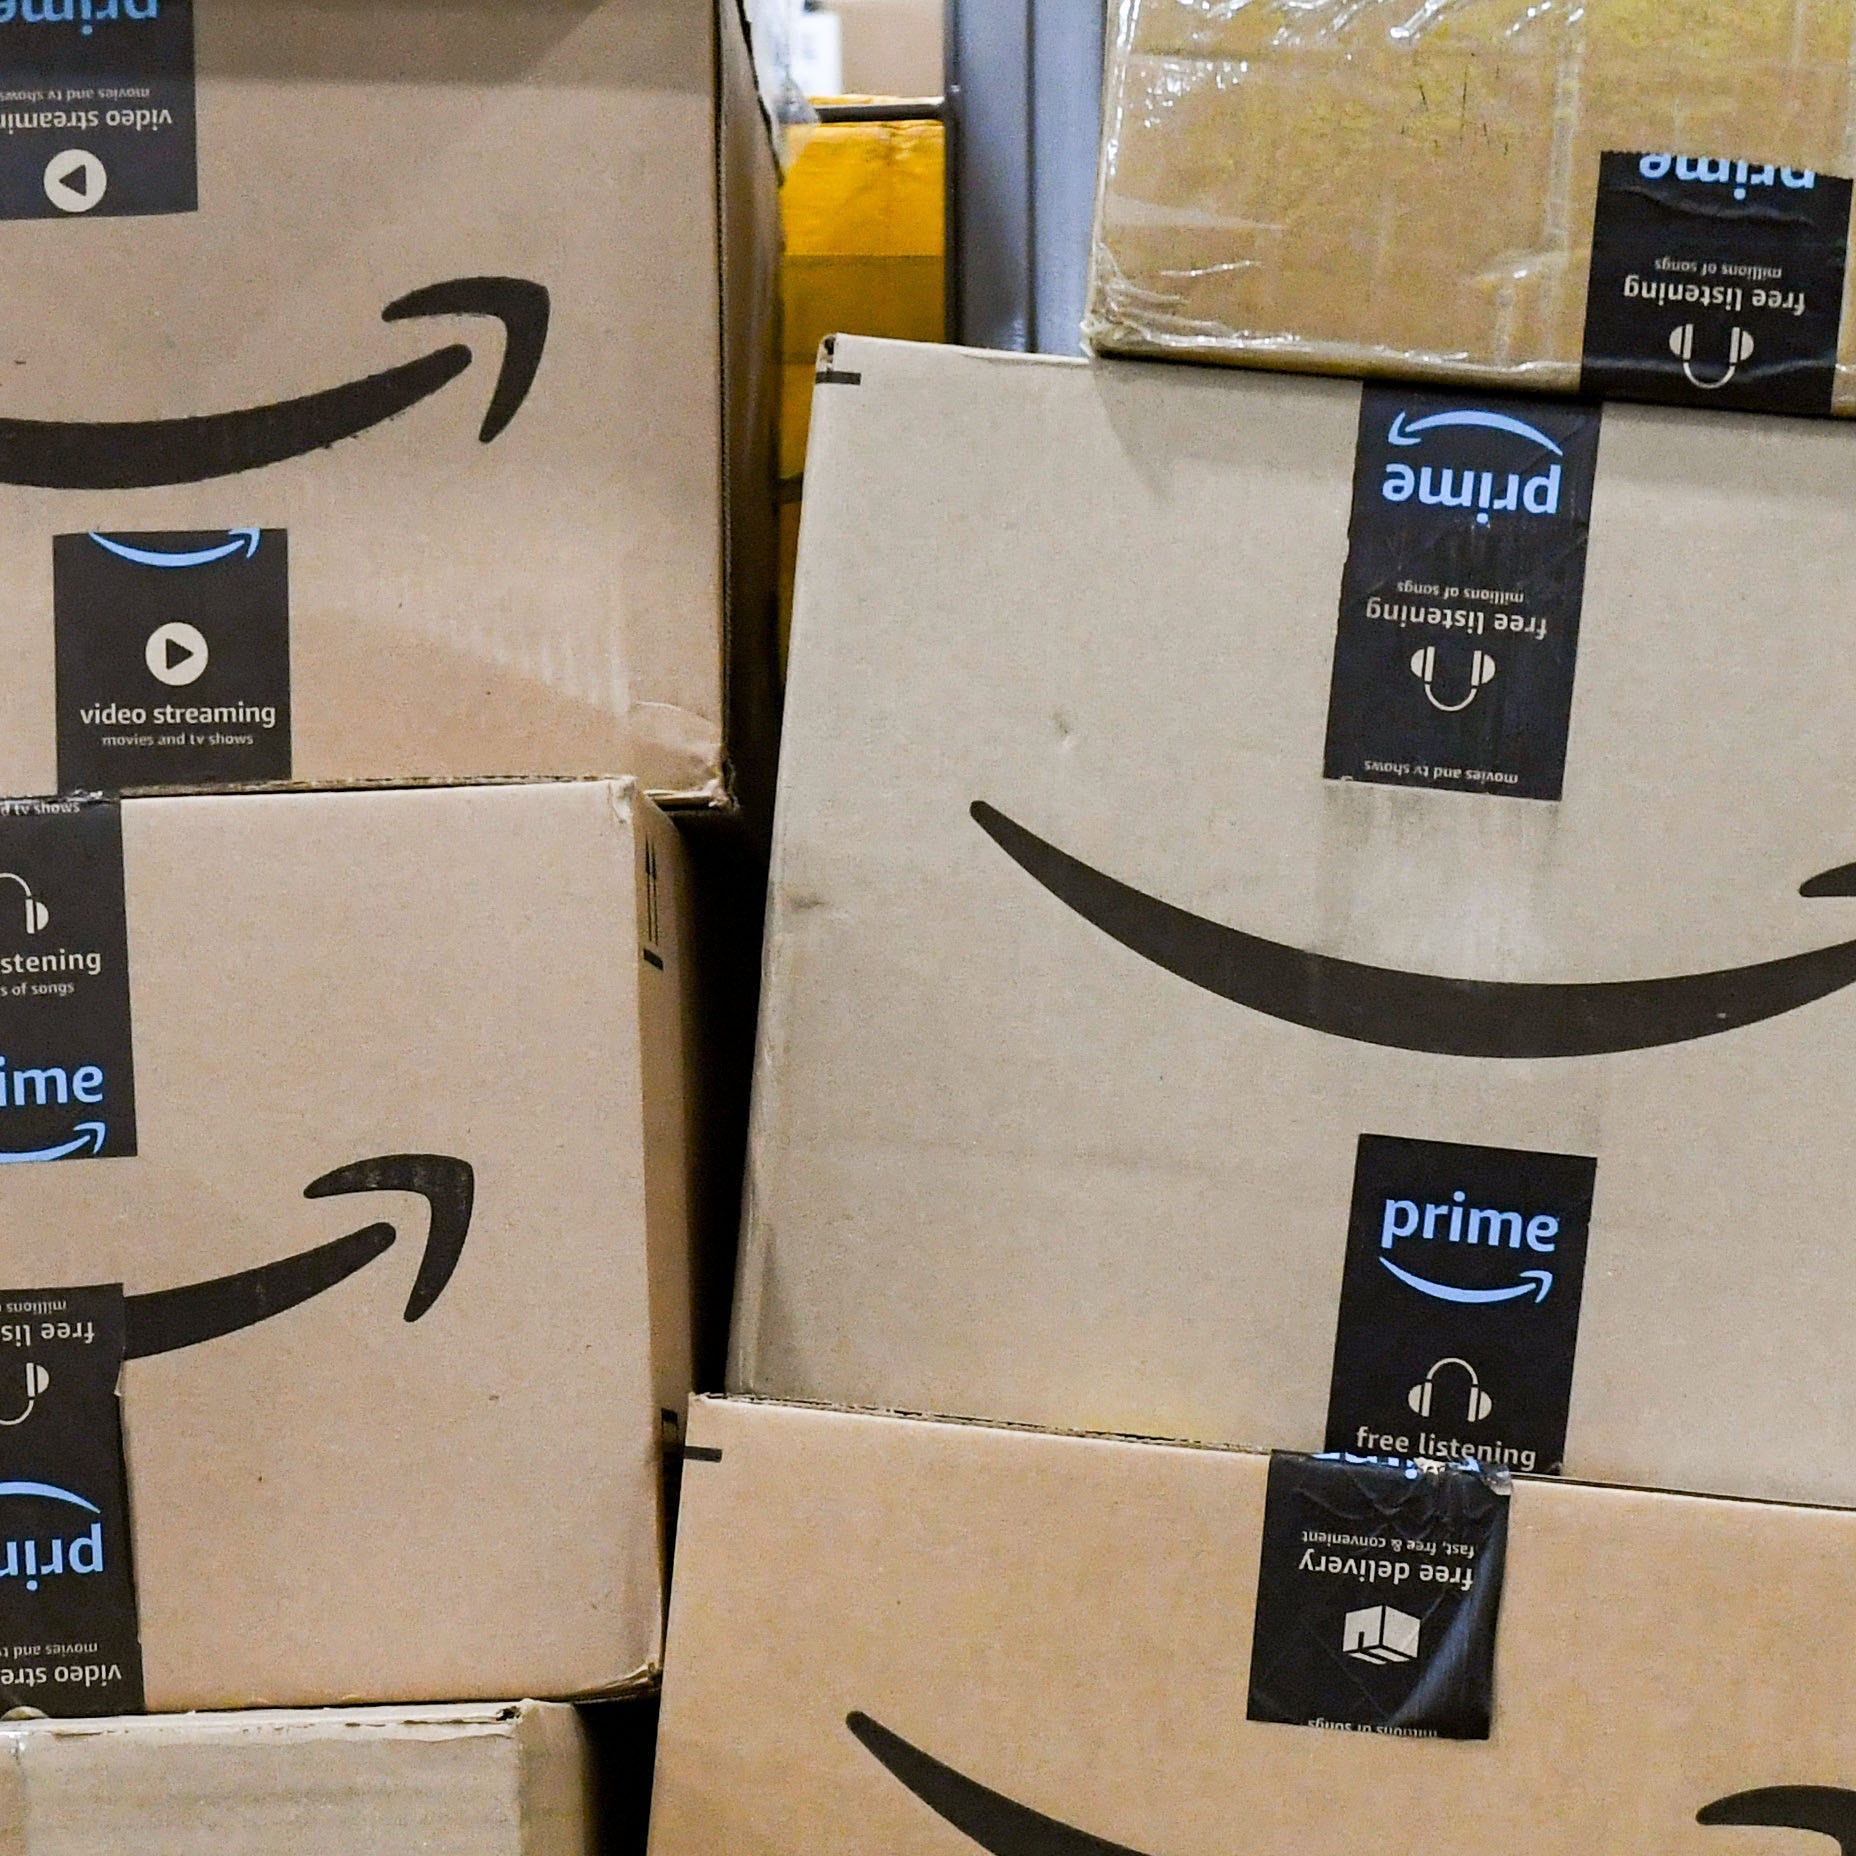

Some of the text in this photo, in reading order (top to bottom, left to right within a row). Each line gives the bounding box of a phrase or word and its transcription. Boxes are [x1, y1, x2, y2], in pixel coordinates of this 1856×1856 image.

[106, 108, 173, 131] video
[1654, 256, 1783, 280] millions of songs
[1623, 275, 1807, 316] free listening
[1381, 462, 1562, 525] prime
[1397, 579, 1525, 604] millions of songs
[1366, 597, 1548, 640] free listening
[80, 701, 276, 729] video streaming
[102, 731, 254, 747] movies and tv shows
[11, 983, 27, 997] of
[31, 981, 75, 997] songs
[1380, 1190, 1559, 1252] prime
[5, 1300, 67, 1314] millions
[40, 1321, 95, 1345] free
[1356, 1426, 1410, 1453] free
[1418, 1432, 1537, 1471] listening
[1301, 1531, 1476, 1559] fast, free & convenient
[1298, 1548, 1475, 1591] free delivery
[53, 1664, 123, 1688] video
